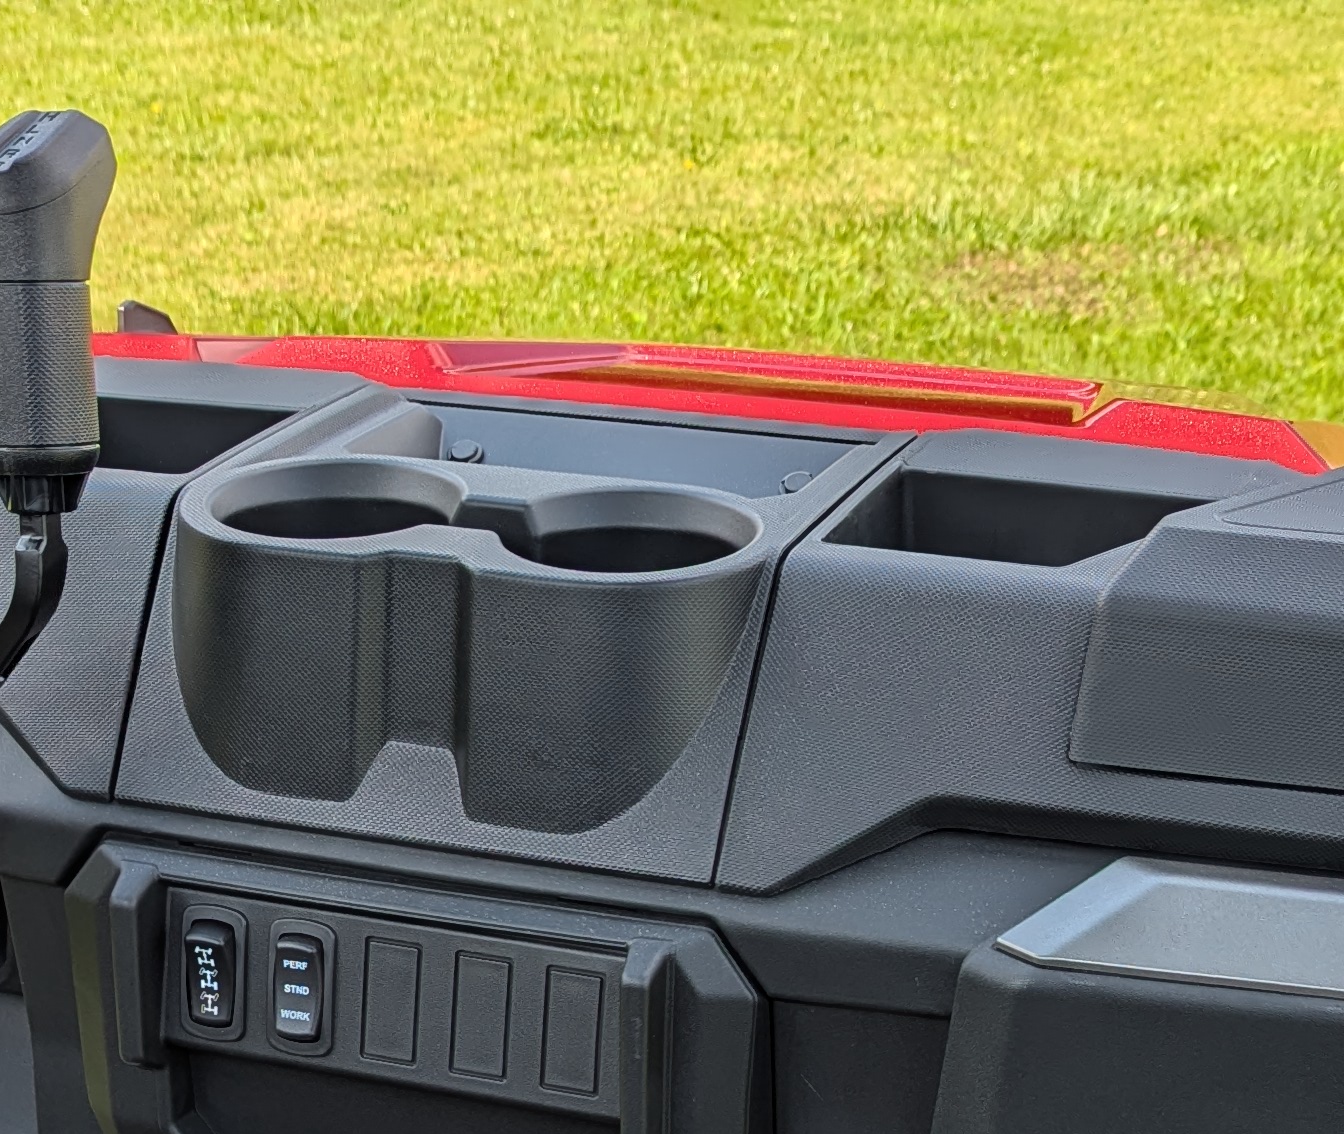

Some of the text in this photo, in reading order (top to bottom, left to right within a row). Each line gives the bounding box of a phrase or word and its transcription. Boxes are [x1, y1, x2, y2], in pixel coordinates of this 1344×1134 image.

[283, 959, 308, 970] PERF
[284, 984, 310, 995] STND
[280, 1009, 310, 1021] WORK
